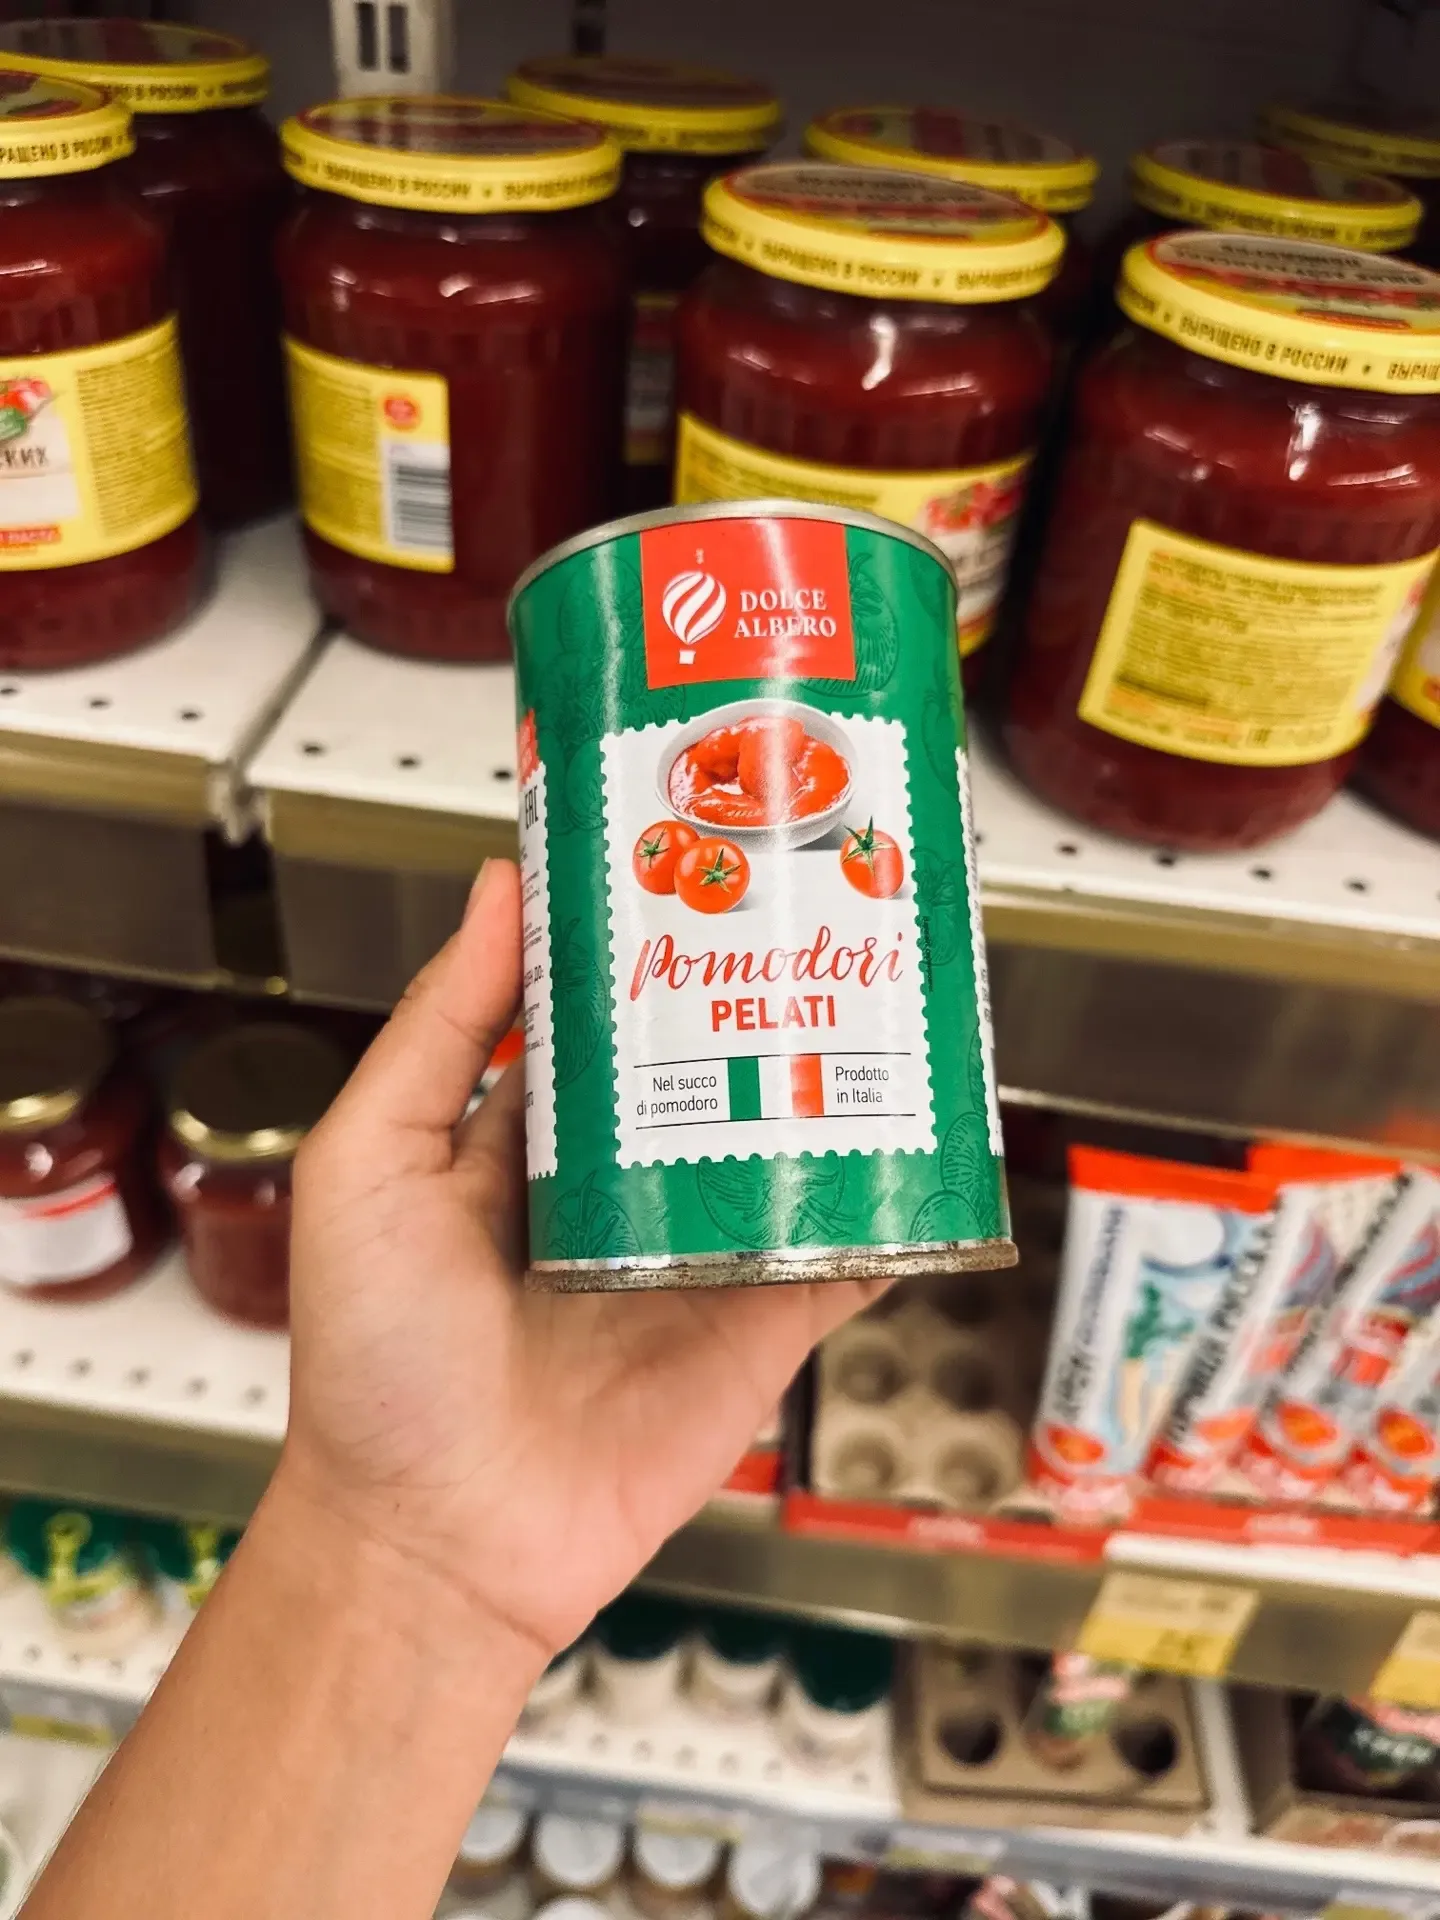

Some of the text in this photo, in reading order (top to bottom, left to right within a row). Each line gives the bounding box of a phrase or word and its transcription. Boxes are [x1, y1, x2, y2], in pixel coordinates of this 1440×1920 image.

[858, 264, 919, 288] РОССИИ
[1178, 314, 1261, 358] ВЫРАЩЕНО
[1265, 342, 1277, 362] В
[1280, 346, 1349, 374] РОССИИ
[740, 588, 828, 613] DOLCE
[733, 614, 837, 639] ALBERO
[630, 925, 903, 1001] Pomodori
[711, 995, 836, 1032] PELATI
[652, 1074, 717, 1092] Nel succo
[835, 1065, 889, 1081] Prodotto
[636, 1094, 718, 1119] di pomodoro
[836, 1087, 883, 1104] in Italia
